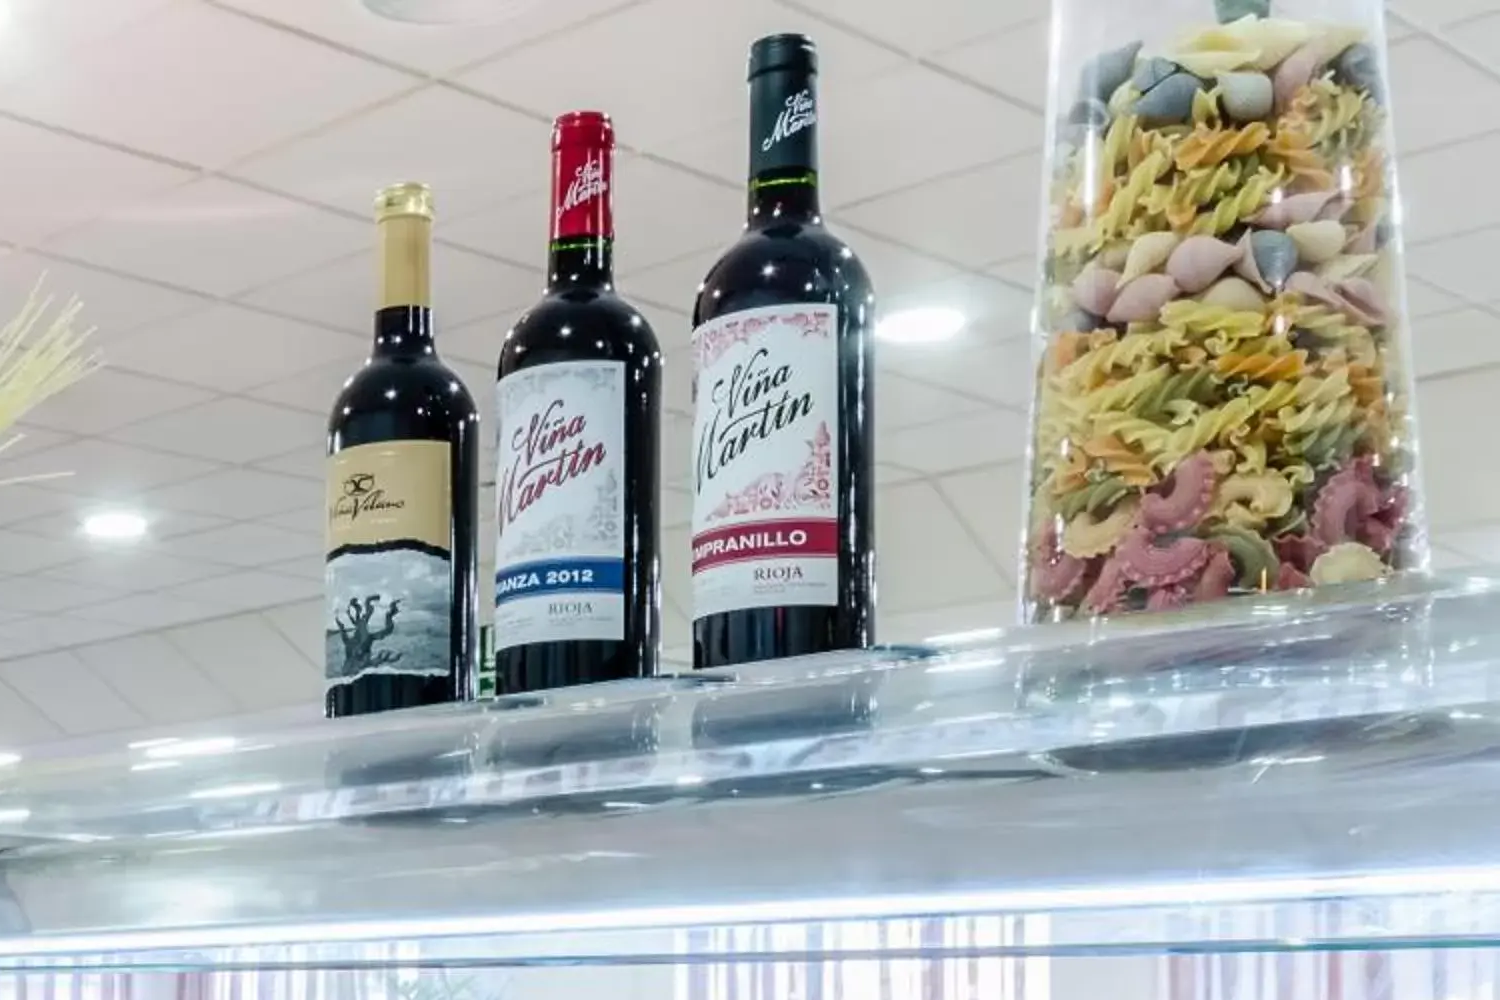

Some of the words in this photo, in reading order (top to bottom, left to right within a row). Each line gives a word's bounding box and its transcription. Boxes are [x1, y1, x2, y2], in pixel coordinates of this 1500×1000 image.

[711, 347, 793, 419] Viña
[511, 398, 588, 466] Viña
[697, 389, 815, 496] Martín
[498, 438, 608, 538] Martín
[545, 568, 595, 586] 2012
[754, 565, 804, 583] RIOJA
[548, 601, 595, 617] RIOJA
